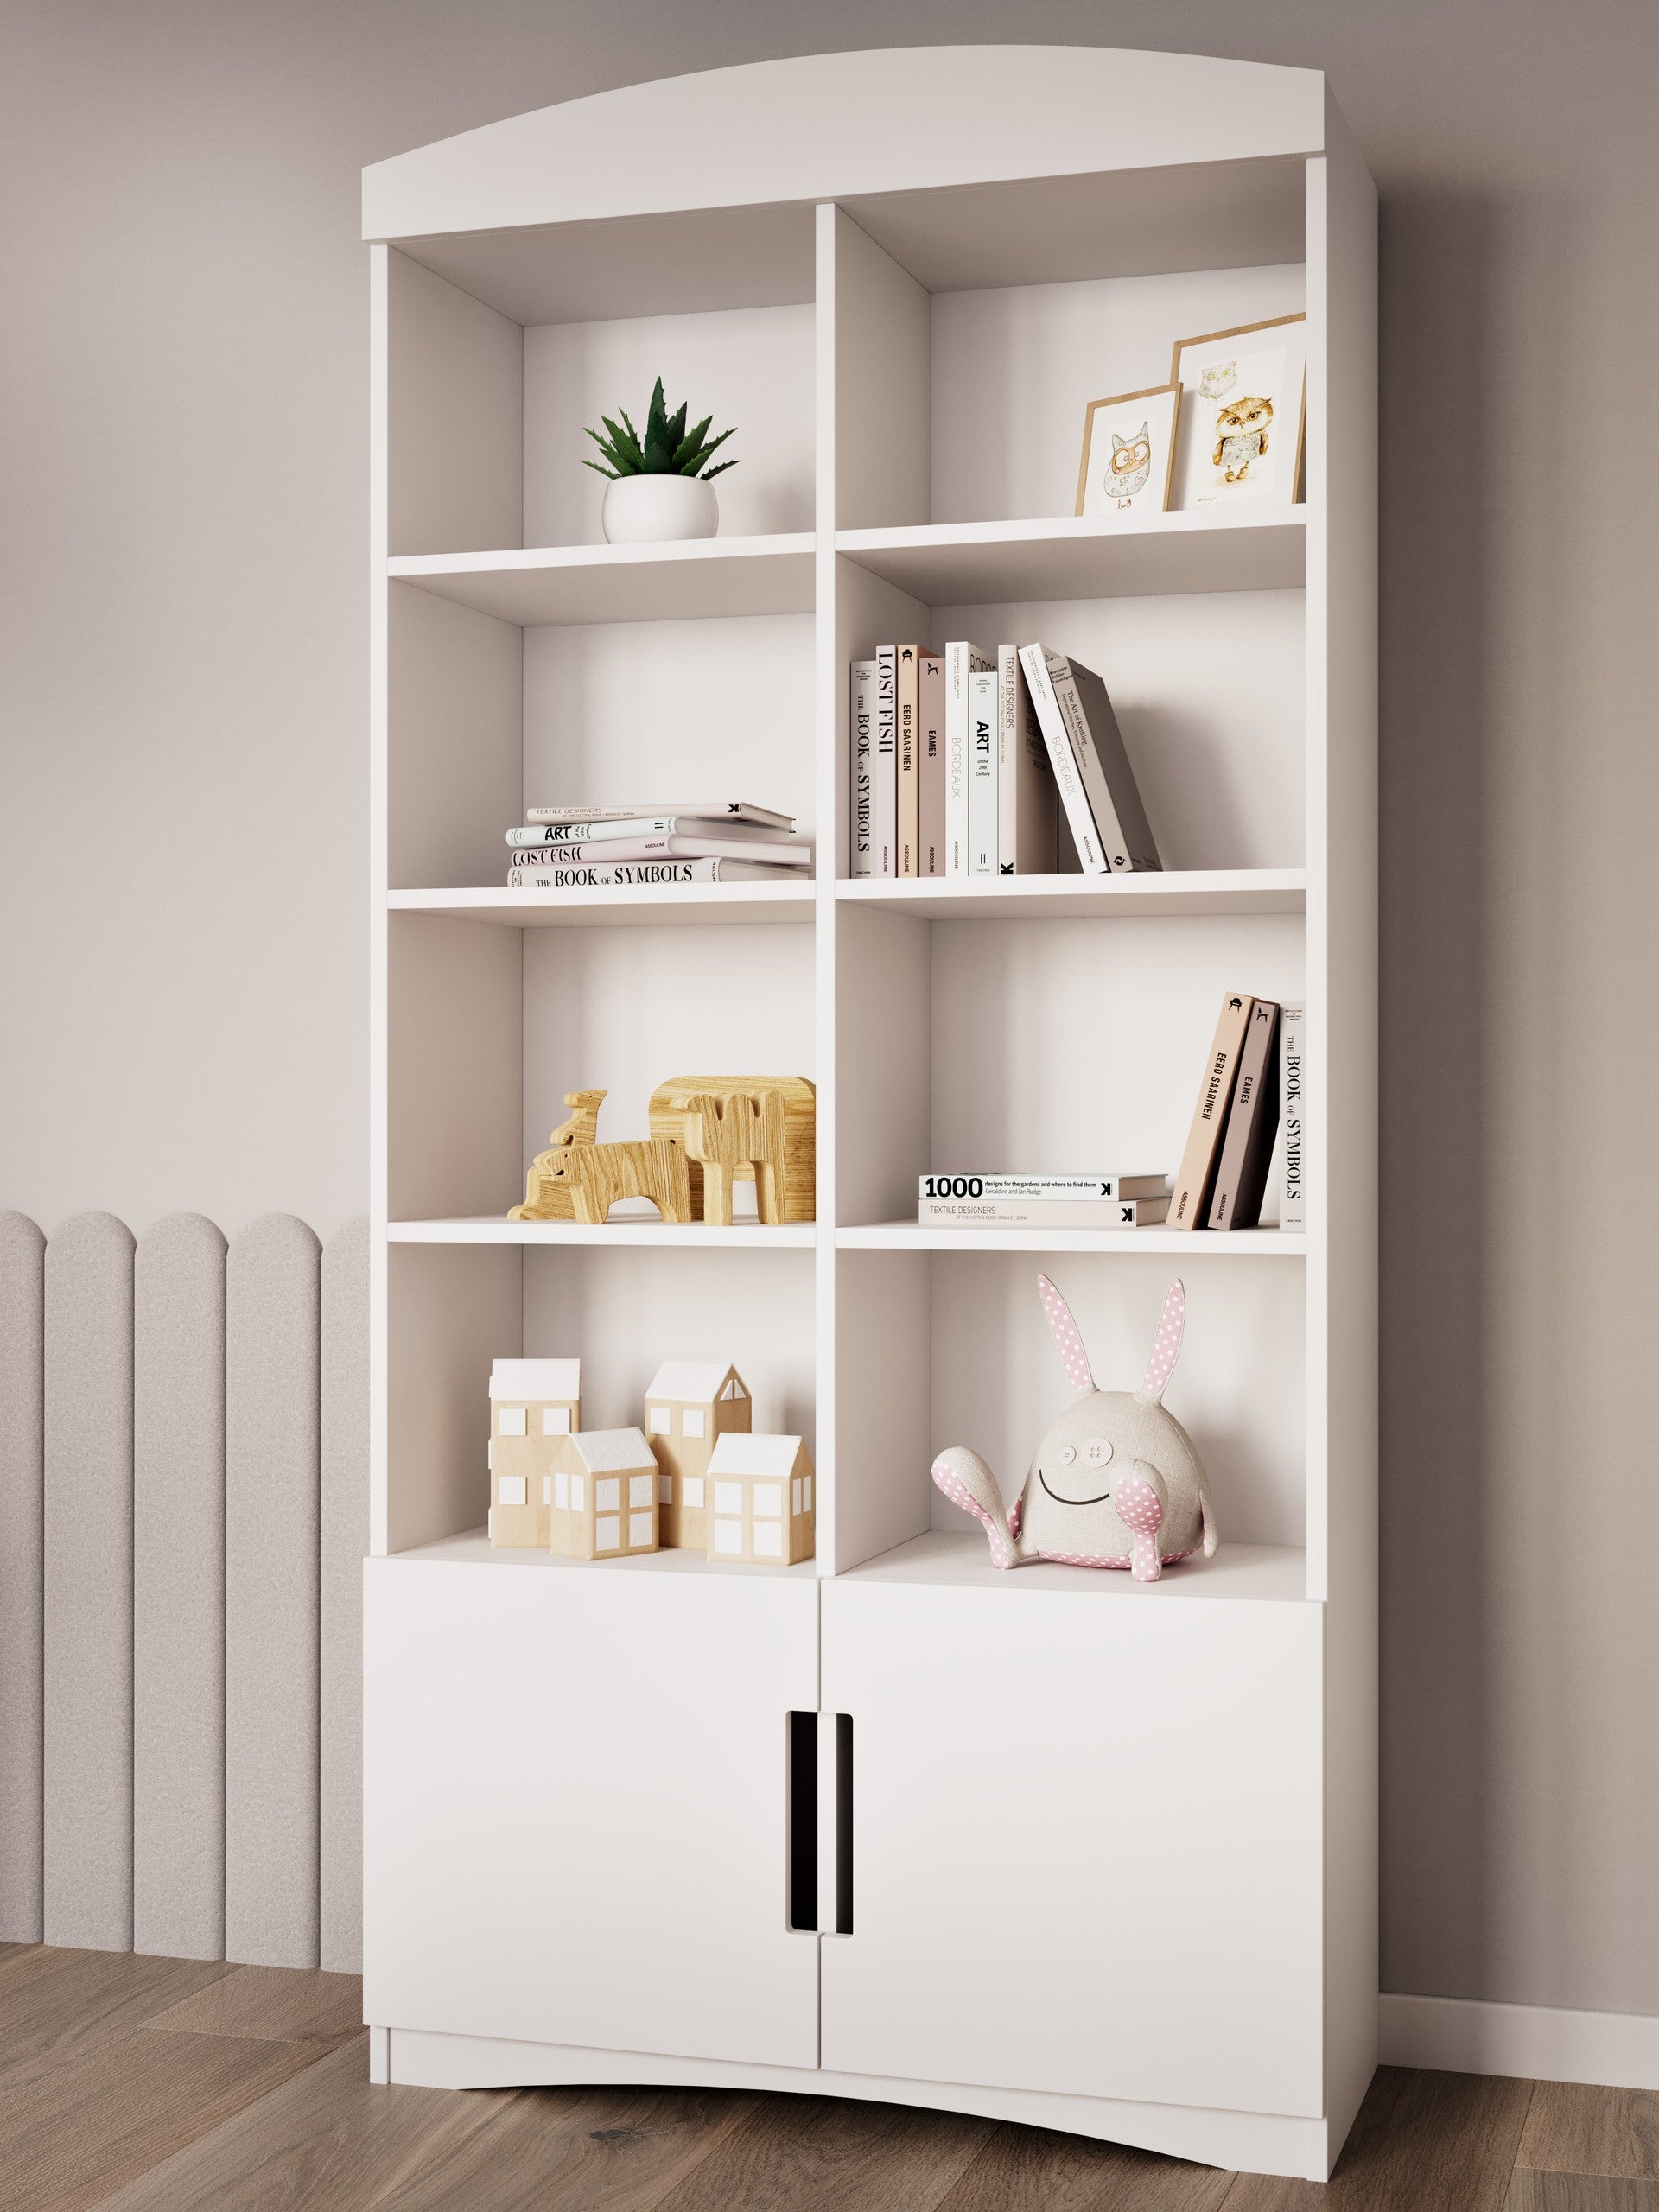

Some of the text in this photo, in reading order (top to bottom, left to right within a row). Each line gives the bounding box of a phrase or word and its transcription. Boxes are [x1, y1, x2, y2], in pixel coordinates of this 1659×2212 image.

[878, 653, 893, 754] LOST FISH
[1005, 657, 1014, 728] TEXTILE DESIGNERS
[857, 714, 870, 759] BOOK
[903, 704, 912, 772] EERO SAARINEN
[928, 730, 937, 758] EAMES
[976, 721, 989, 753] ART
[1077, 721, 1088, 746] Knitting
[857, 761, 864, 772] OF
[951, 737, 961, 798] BORDEAUX
[1052, 736, 1077, 796] BORDEAUX
[857, 774, 870, 853] SYMBOLS
[544, 825, 572, 841] ART
[512, 846, 582, 867] LOST FISH
[555, 868, 599, 887] BOOK
[601, 876, 612, 885] OF
[614, 864, 693, 884] SYMBOLS
[1201, 1052, 1227, 1120] EERO SAARINEN
[1240, 1077, 1254, 1104] EAMES
[1287, 1056, 1300, 1101] BOOK
[1287, 1104, 1294, 1116] OF
[1287, 1119, 1300, 1199] SYMBOLS
[925, 1177, 983, 1198] 1000
[930, 1205, 996, 1215] TEXTILE DESIGNERS
[1176, 1191, 1188, 1219] ASSOULINE
[1217, 1193, 1227, 1221] ASSOULINE
